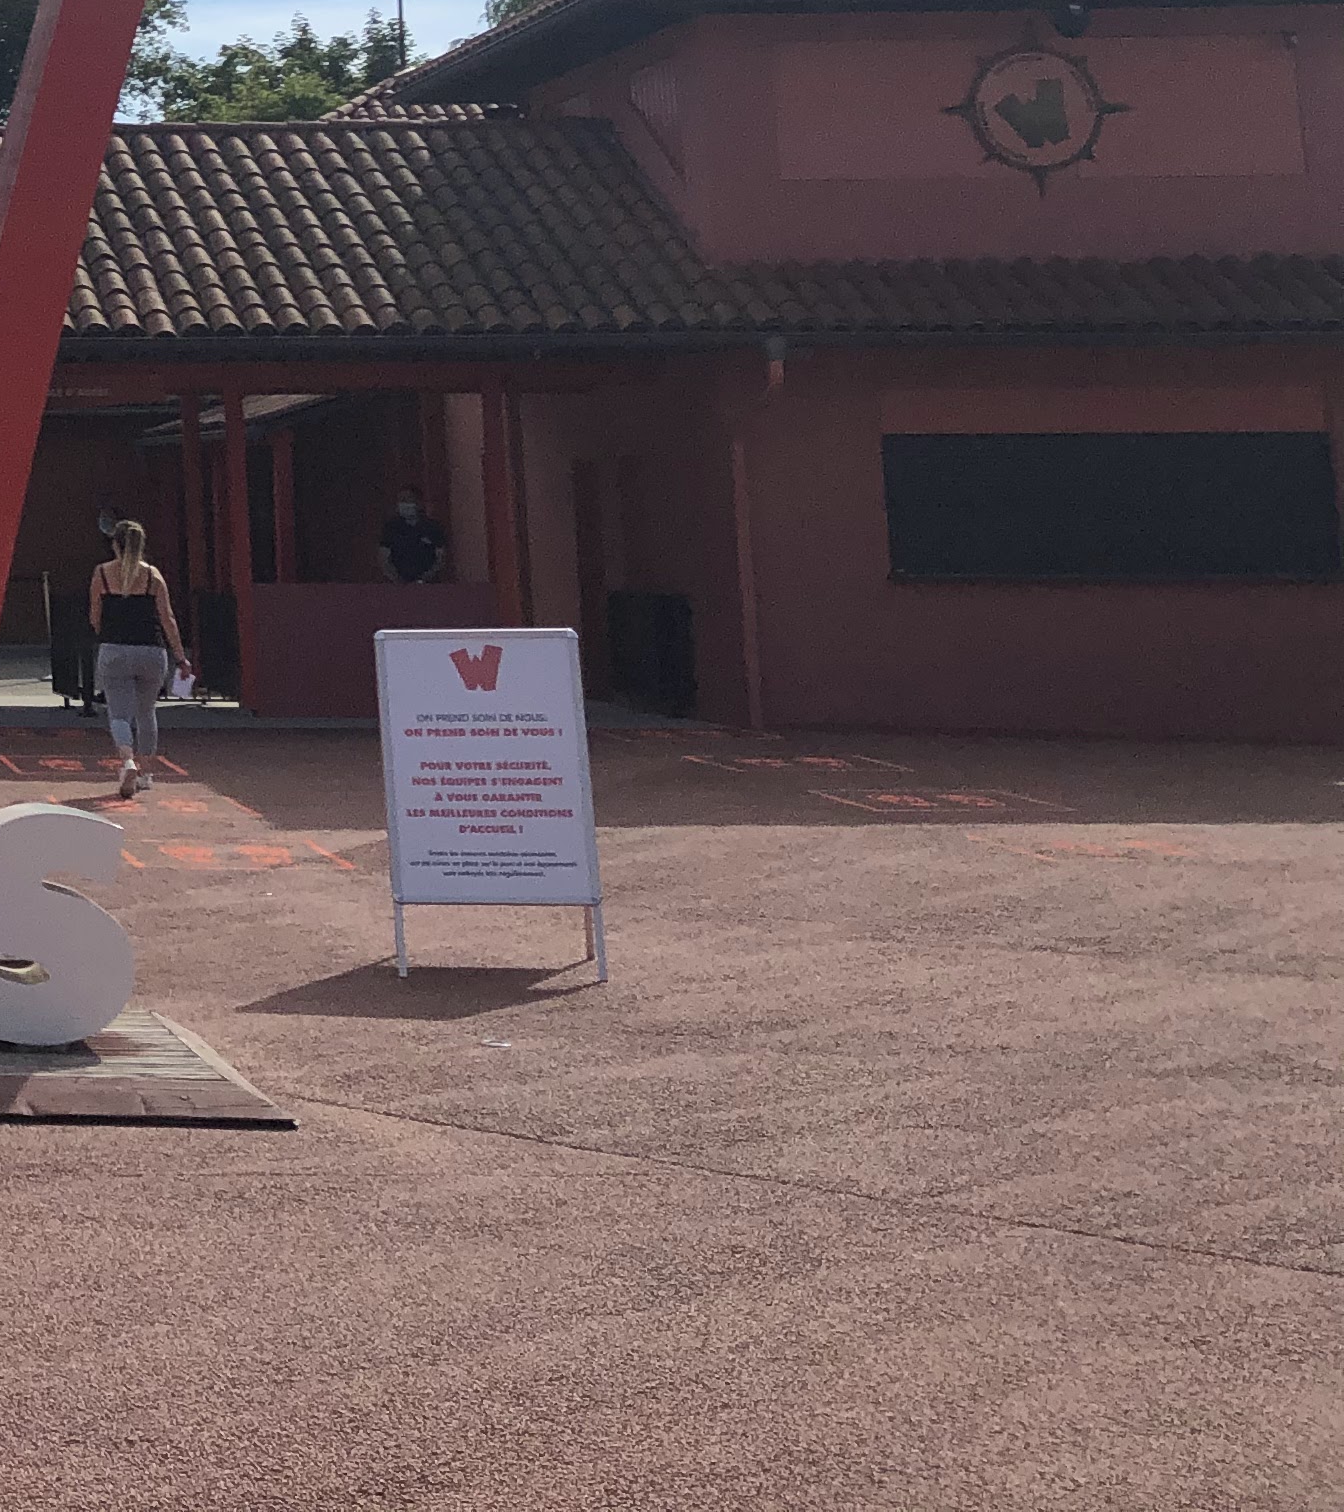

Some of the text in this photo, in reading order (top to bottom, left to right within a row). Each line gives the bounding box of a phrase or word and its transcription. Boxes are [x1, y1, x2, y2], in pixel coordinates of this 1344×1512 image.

[416, 713, 434, 723] ON
[436, 713, 470, 723] PREND
[499, 713, 513, 723] DE
[404, 727, 423, 737] ON
[426, 728, 466, 737] PREND
[503, 728, 519, 737] DE
[521, 728, 555, 737] VOUS
[420, 761, 452, 771] POUR
[455, 761, 492, 771] VOTRE
[412, 775, 564, 787] NOS ÉQUIPES S'ENGAGENT
[434, 792, 543, 802] À VOUS GARANTIR
[406, 809, 426, 817] LES
[500, 809, 574, 817] CONDITIONS
[458, 824, 517, 834] D'ACCUEIL
